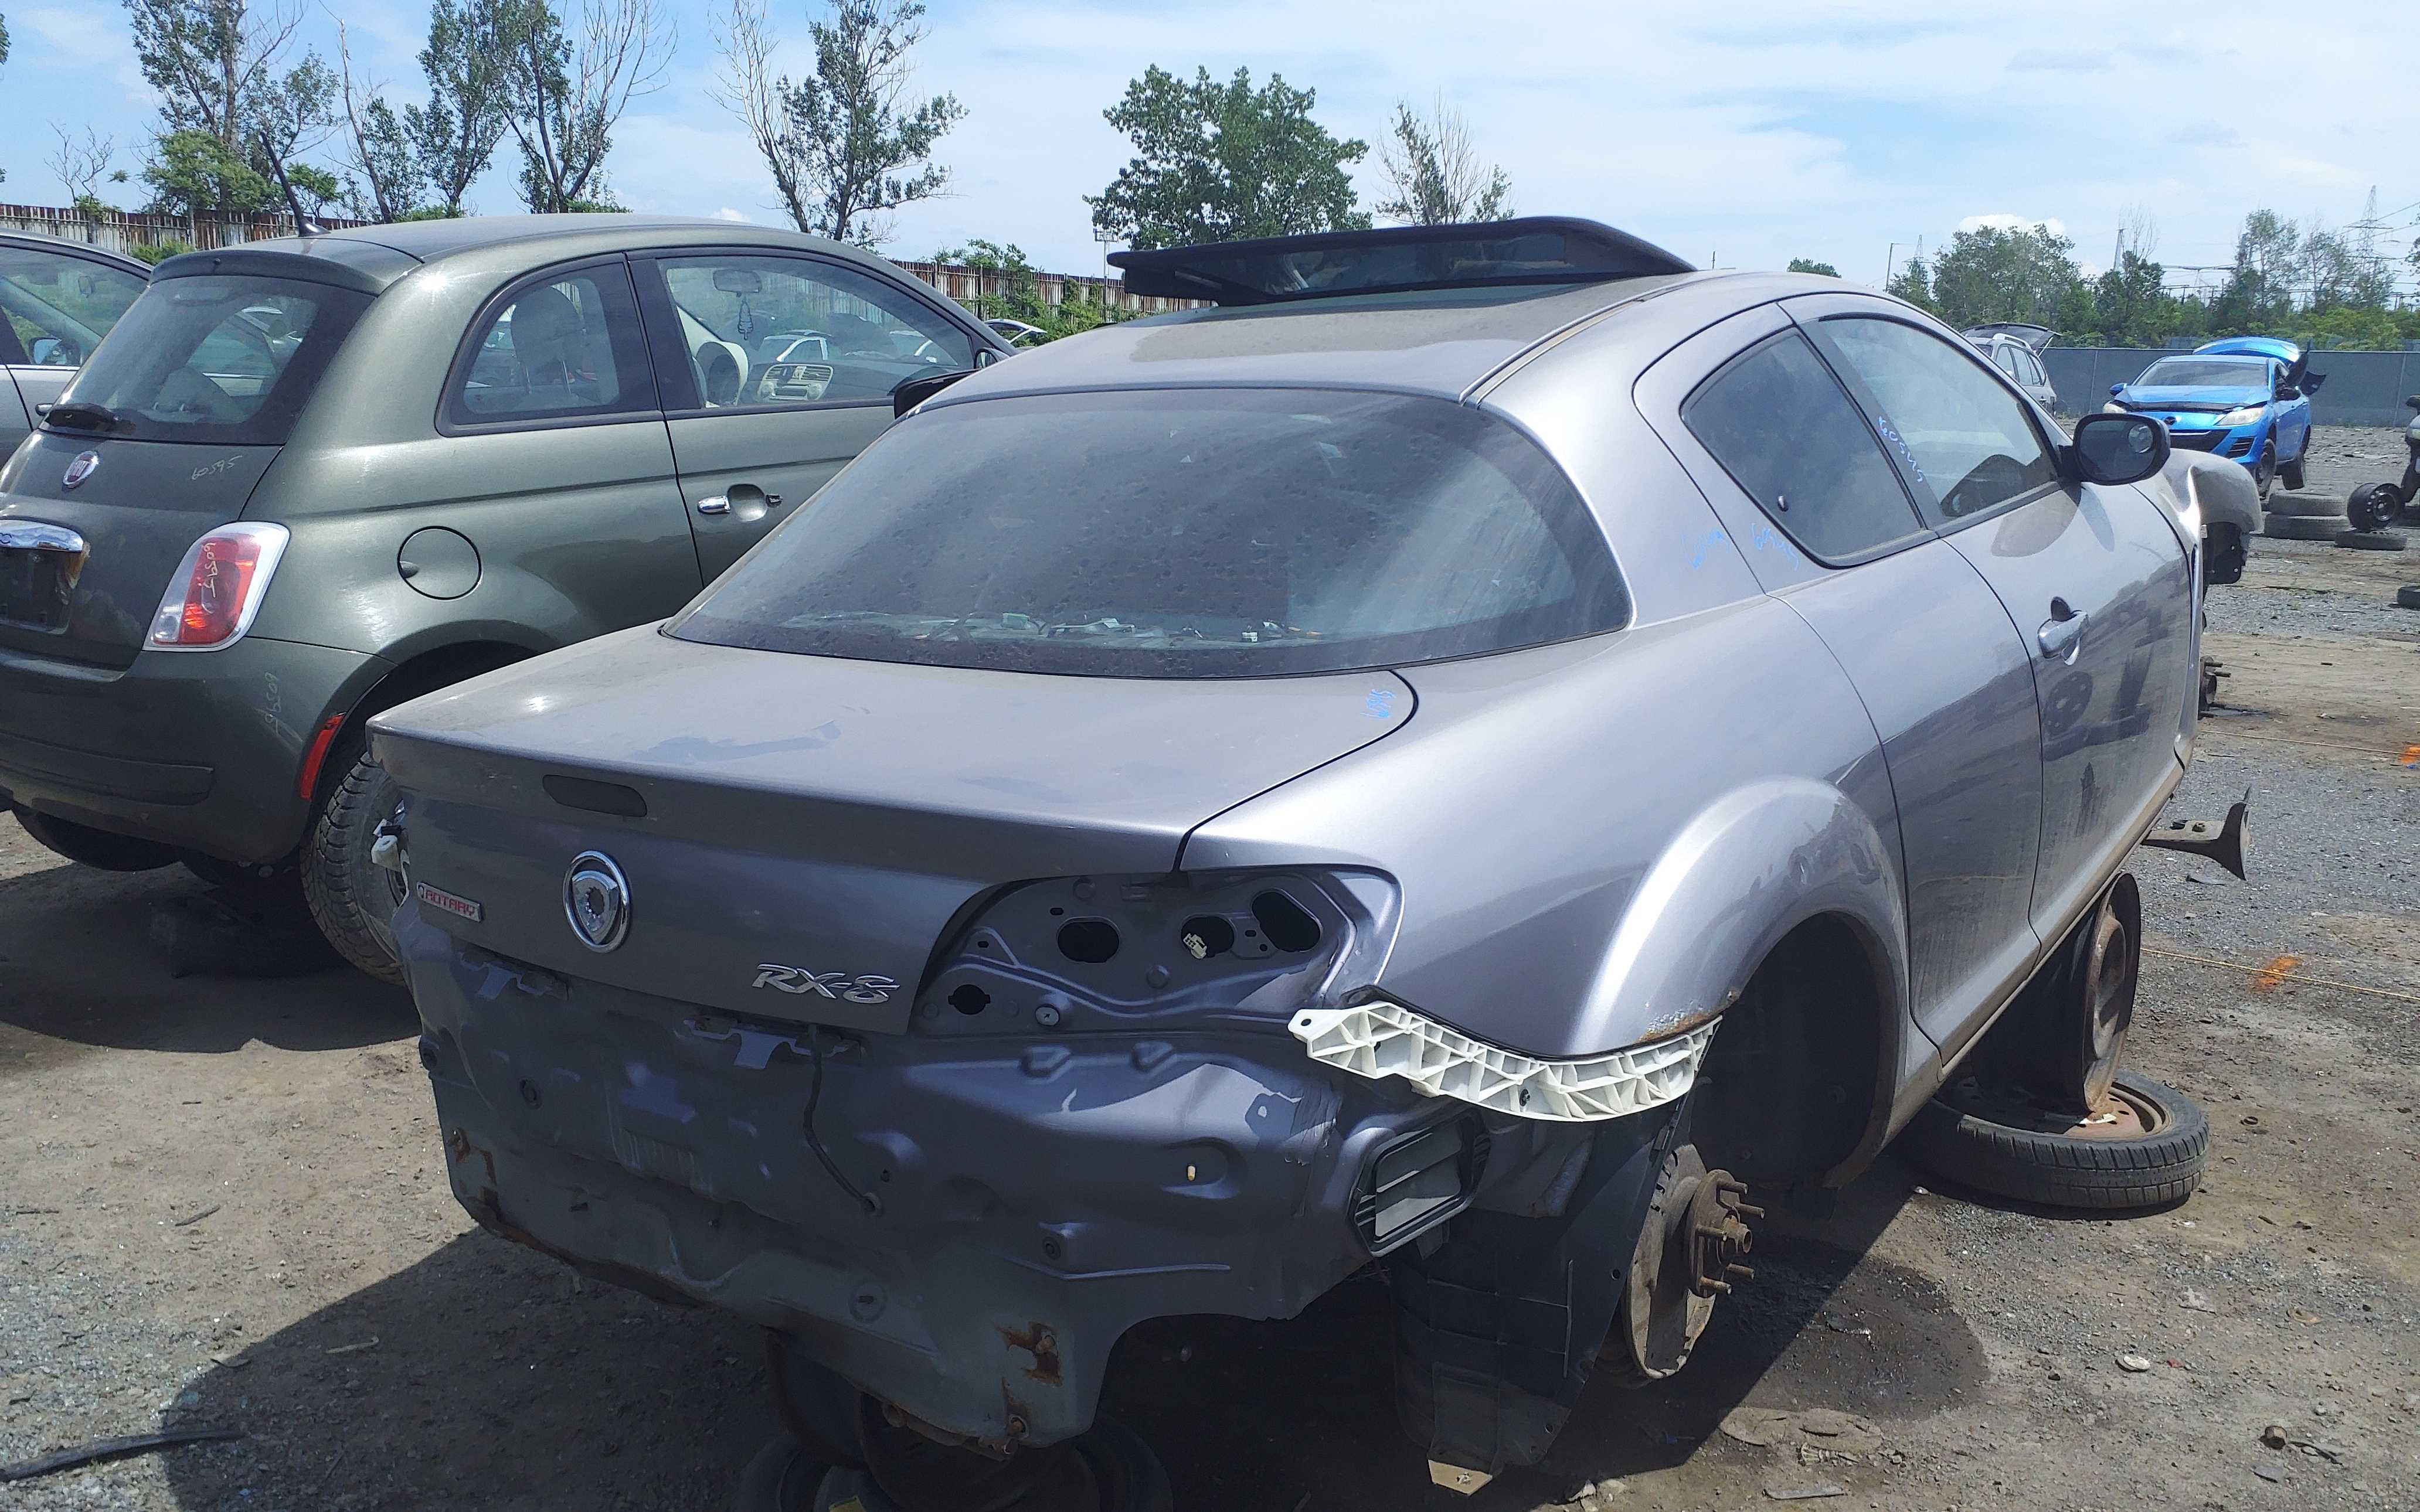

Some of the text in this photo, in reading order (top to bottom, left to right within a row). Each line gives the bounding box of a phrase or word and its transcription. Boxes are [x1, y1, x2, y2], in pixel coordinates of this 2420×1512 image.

[191, 455, 243, 480] 60595
[203, 543, 218, 598] 60595
[425, 890, 475, 916] ROTARY
[752, 963, 901, 1004] RX-8
